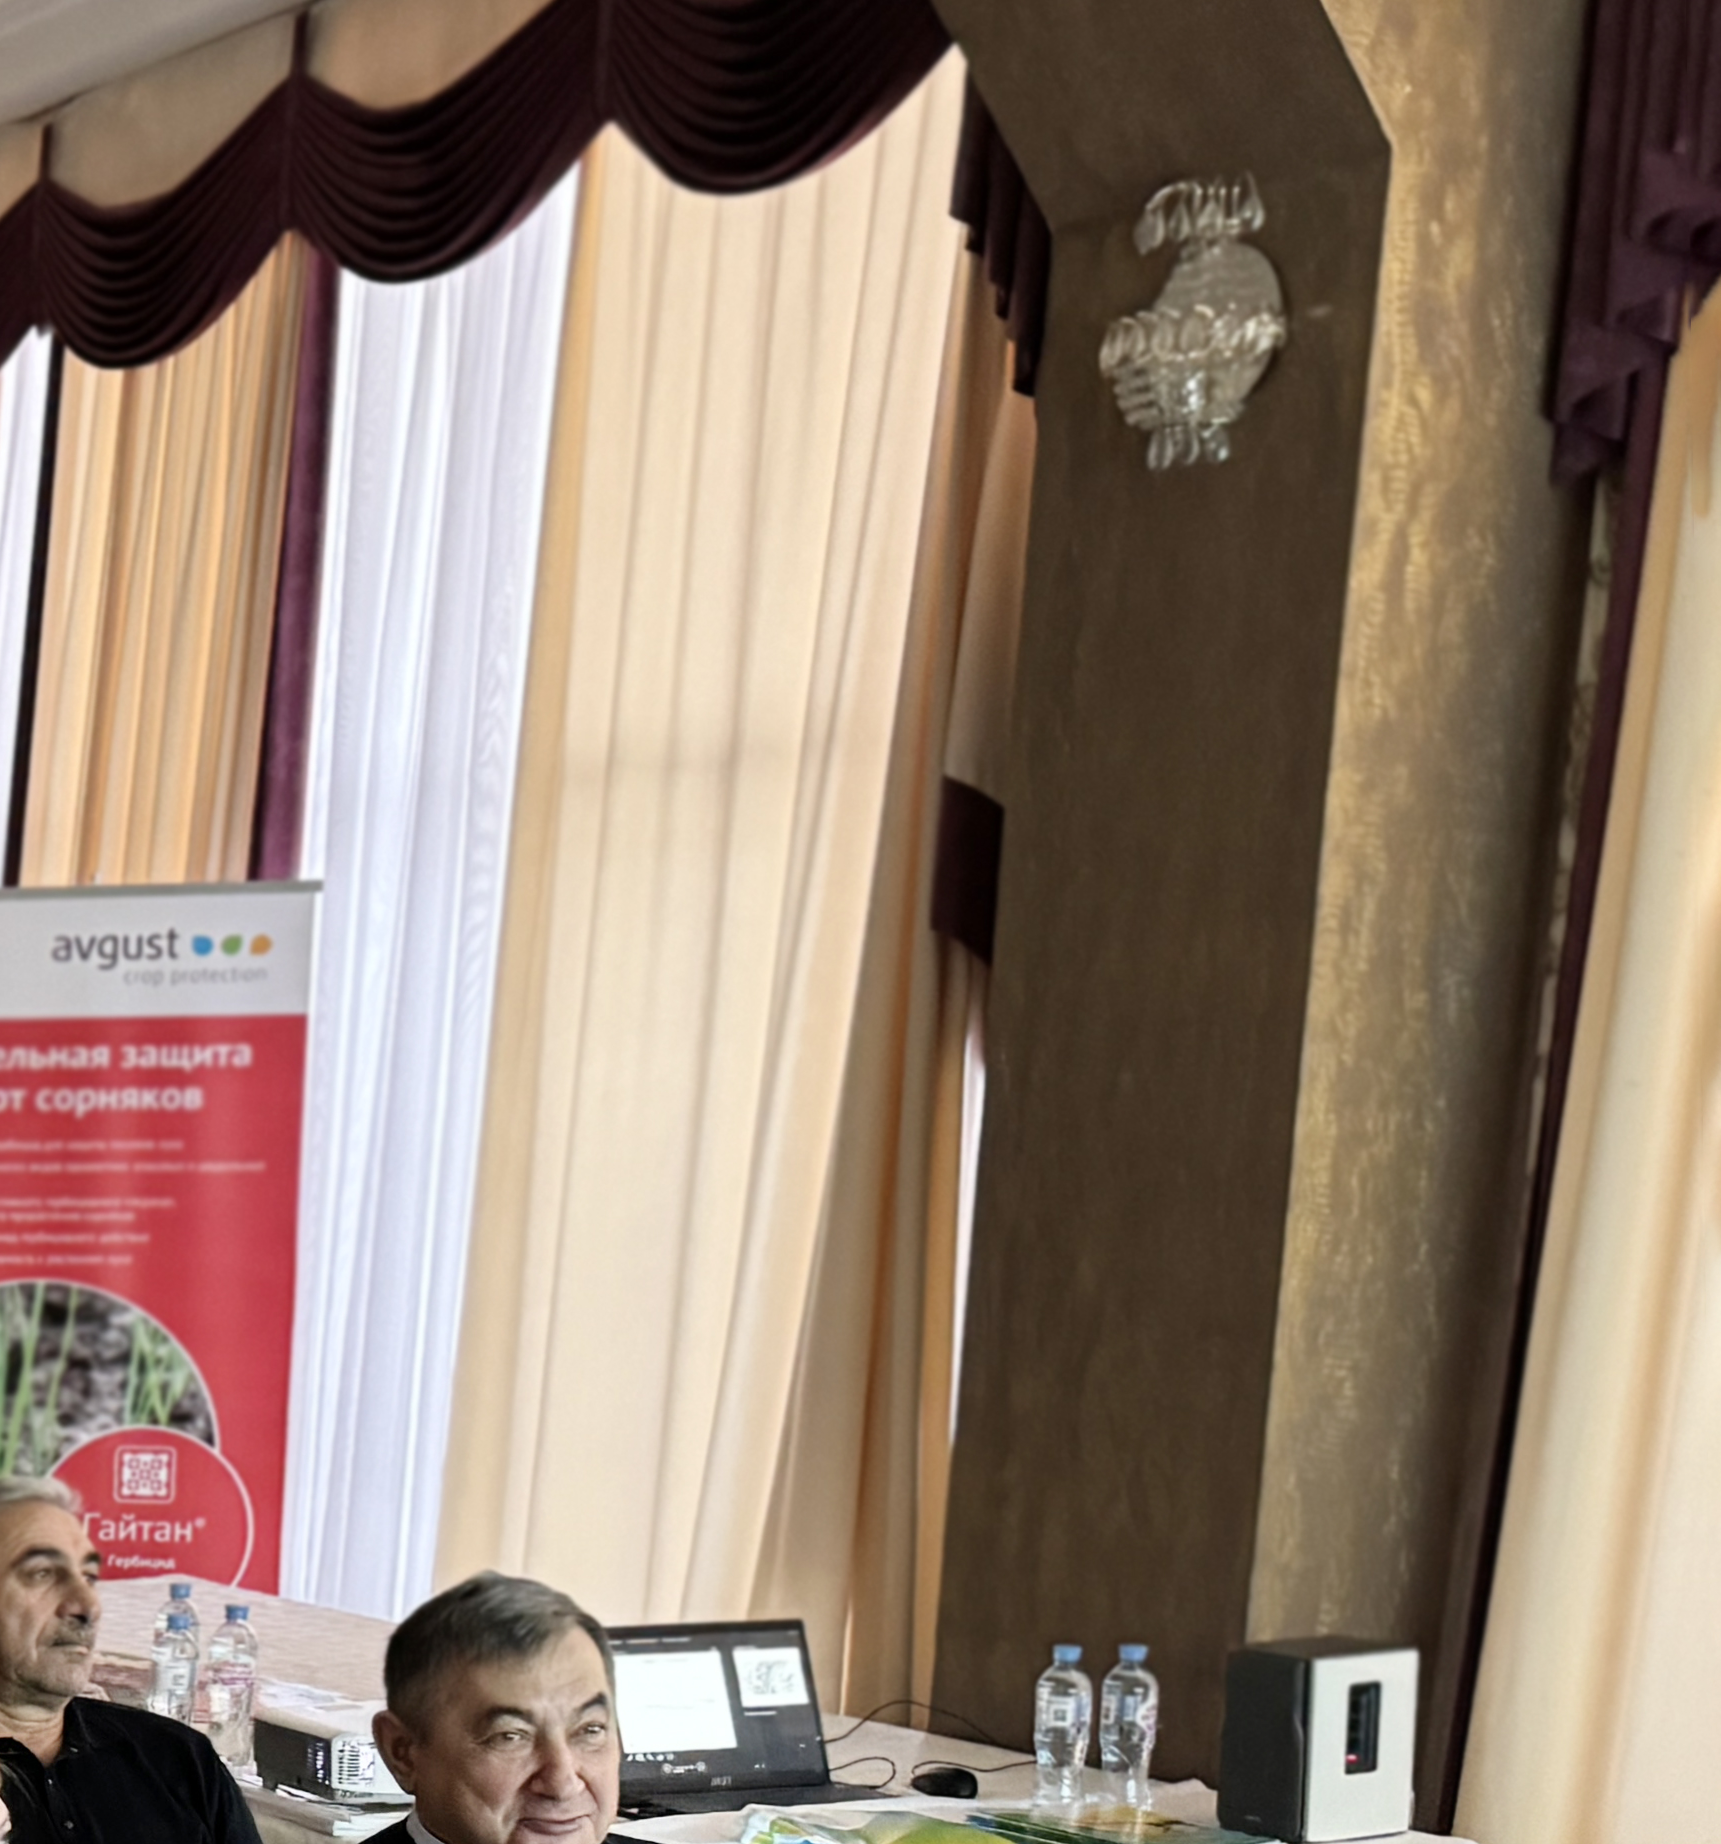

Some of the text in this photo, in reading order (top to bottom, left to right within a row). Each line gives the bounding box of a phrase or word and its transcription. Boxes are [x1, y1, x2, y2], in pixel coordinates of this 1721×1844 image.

[51, 927, 179, 970] avgust
[122, 965, 269, 987] crop protection
[120, 1042, 253, 1074] защита
[36, 1086, 205, 1120] сорняков
[83, 1512, 193, 1543] Гайтан
[107, 1554, 176, 1572] Гербицид
